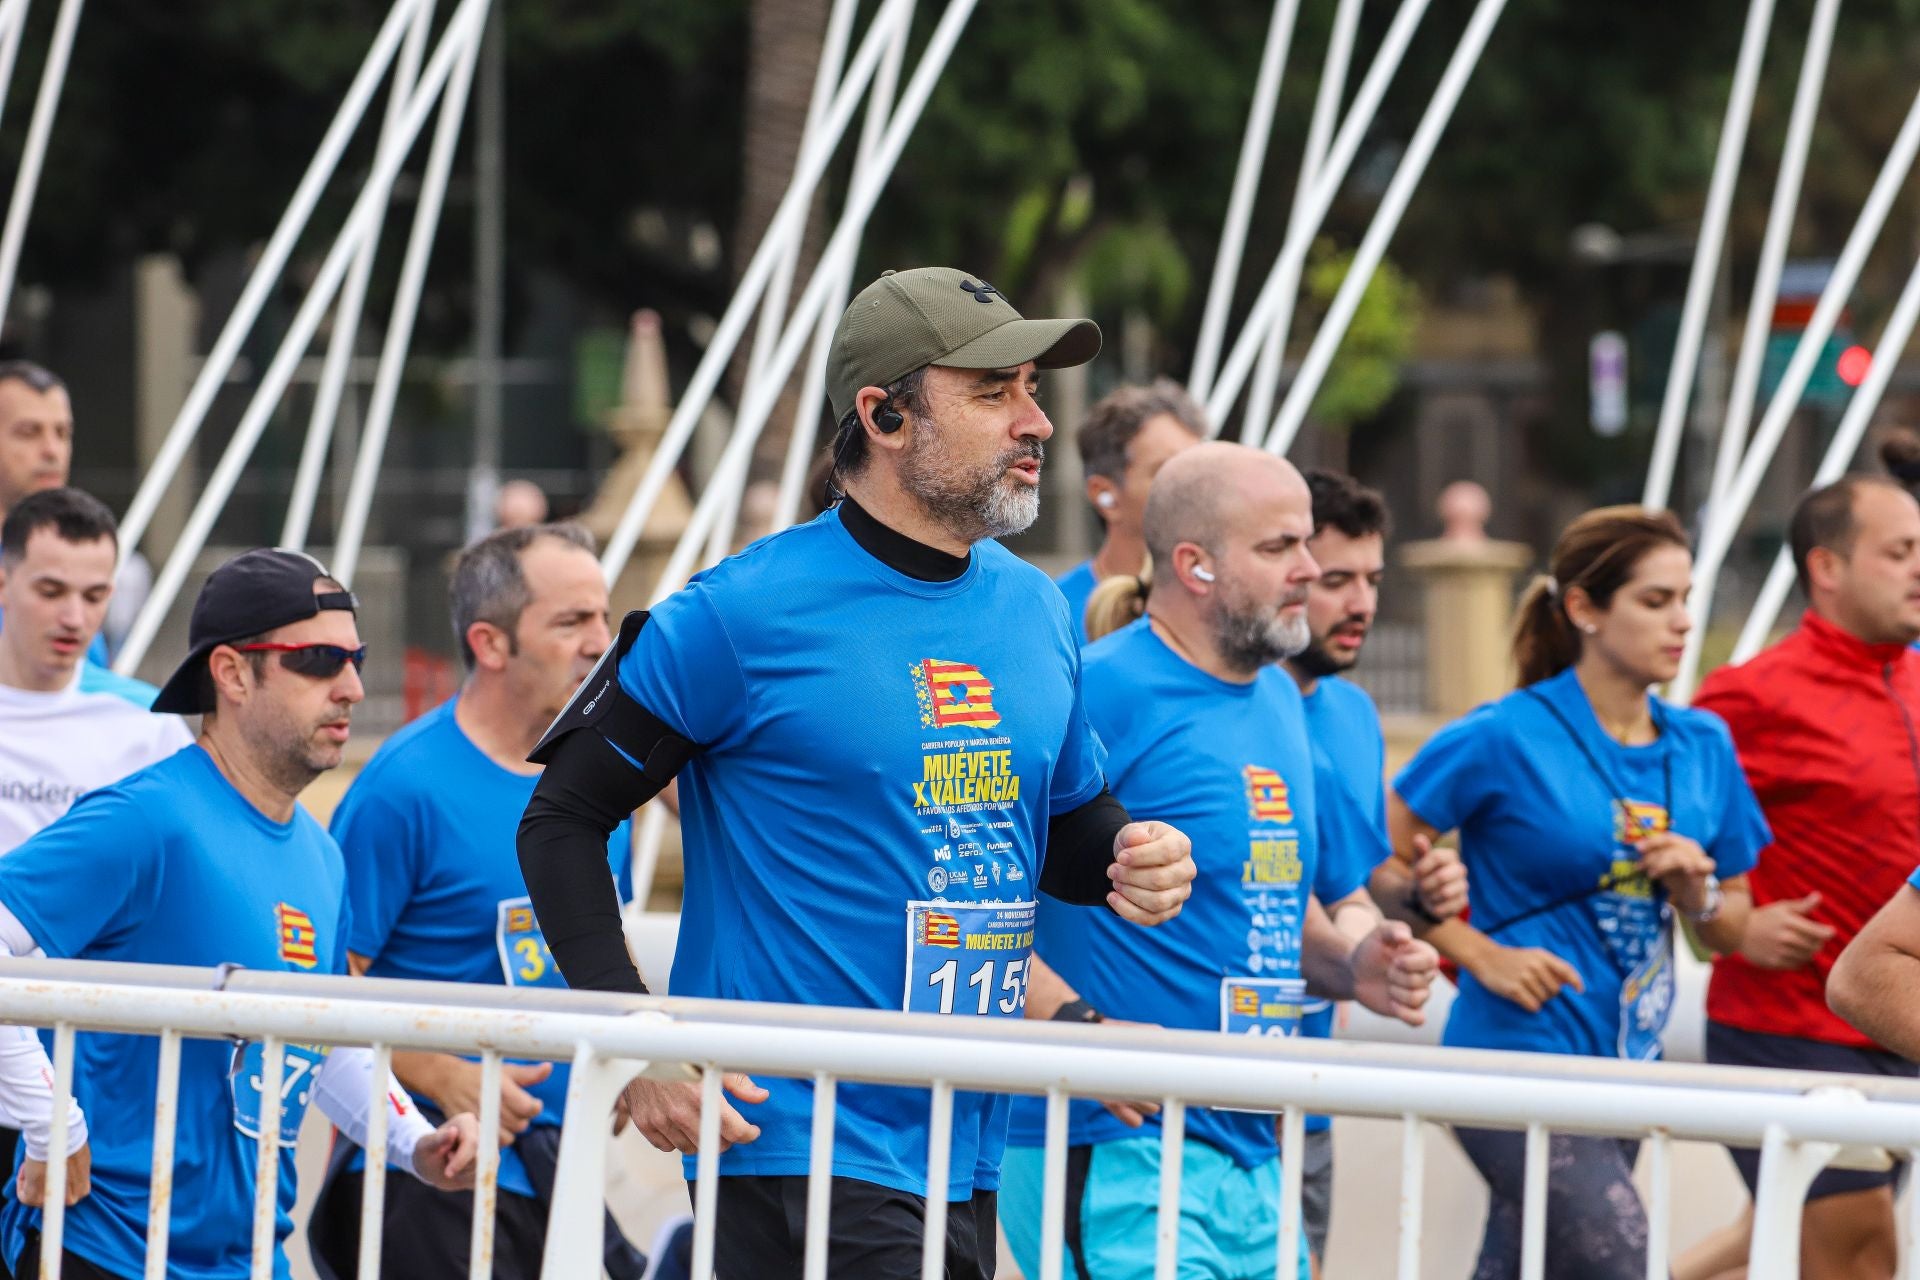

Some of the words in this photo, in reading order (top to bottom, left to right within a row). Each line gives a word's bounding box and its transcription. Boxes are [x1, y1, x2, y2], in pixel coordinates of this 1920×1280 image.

[922, 742, 943, 750] CARRERA
[945, 740, 965, 748] POPULAR
[970, 737, 989, 746] MARCHA
[923, 747, 1012, 782] MUÉVETE
[912, 781, 929, 808] X
[930, 776, 1020, 806] VALENCIA
[917, 808, 922, 816] A
[983, 802, 996, 812] POR
[966, 931, 1015, 950] MUÉVETE
[1015, 932, 1023, 949] X
